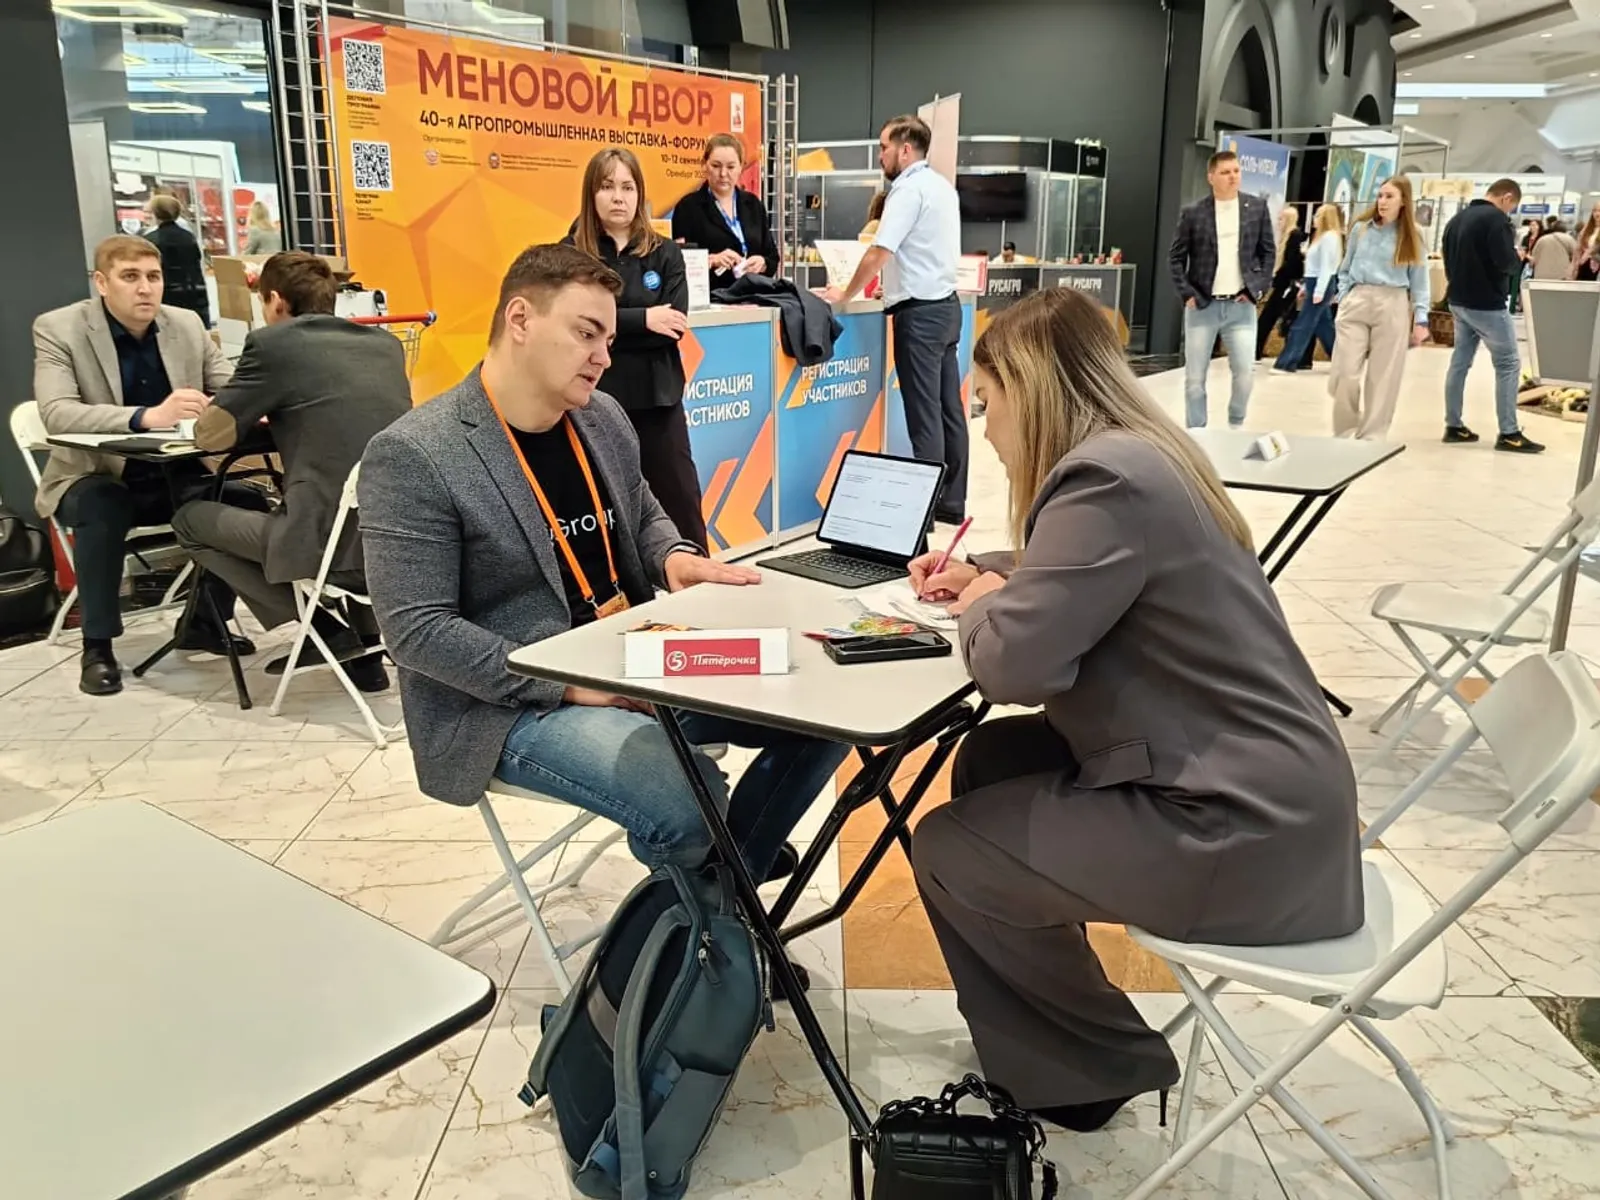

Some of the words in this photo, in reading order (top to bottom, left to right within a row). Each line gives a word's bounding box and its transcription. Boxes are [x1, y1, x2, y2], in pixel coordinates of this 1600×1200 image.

[418, 49, 618, 117] МЕНОВОЙ
[628, 81, 713, 128] ДВОР
[420, 110, 454, 128] 40-я
[458, 114, 606, 142] АГРОПРОМЫШЛЕННАЯ
[988, 279, 1022, 293] РУСАГРО
[1073, 277, 1102, 290] РУСАГРО
[801, 356, 870, 381] РЕГИСТРАЦИЯ
[685, 374, 754, 401] ИСТРАЦИЯ
[801, 380, 867, 405] УЧАСТНИКОВ
[685, 400, 751, 428] АСТНИКОВ
